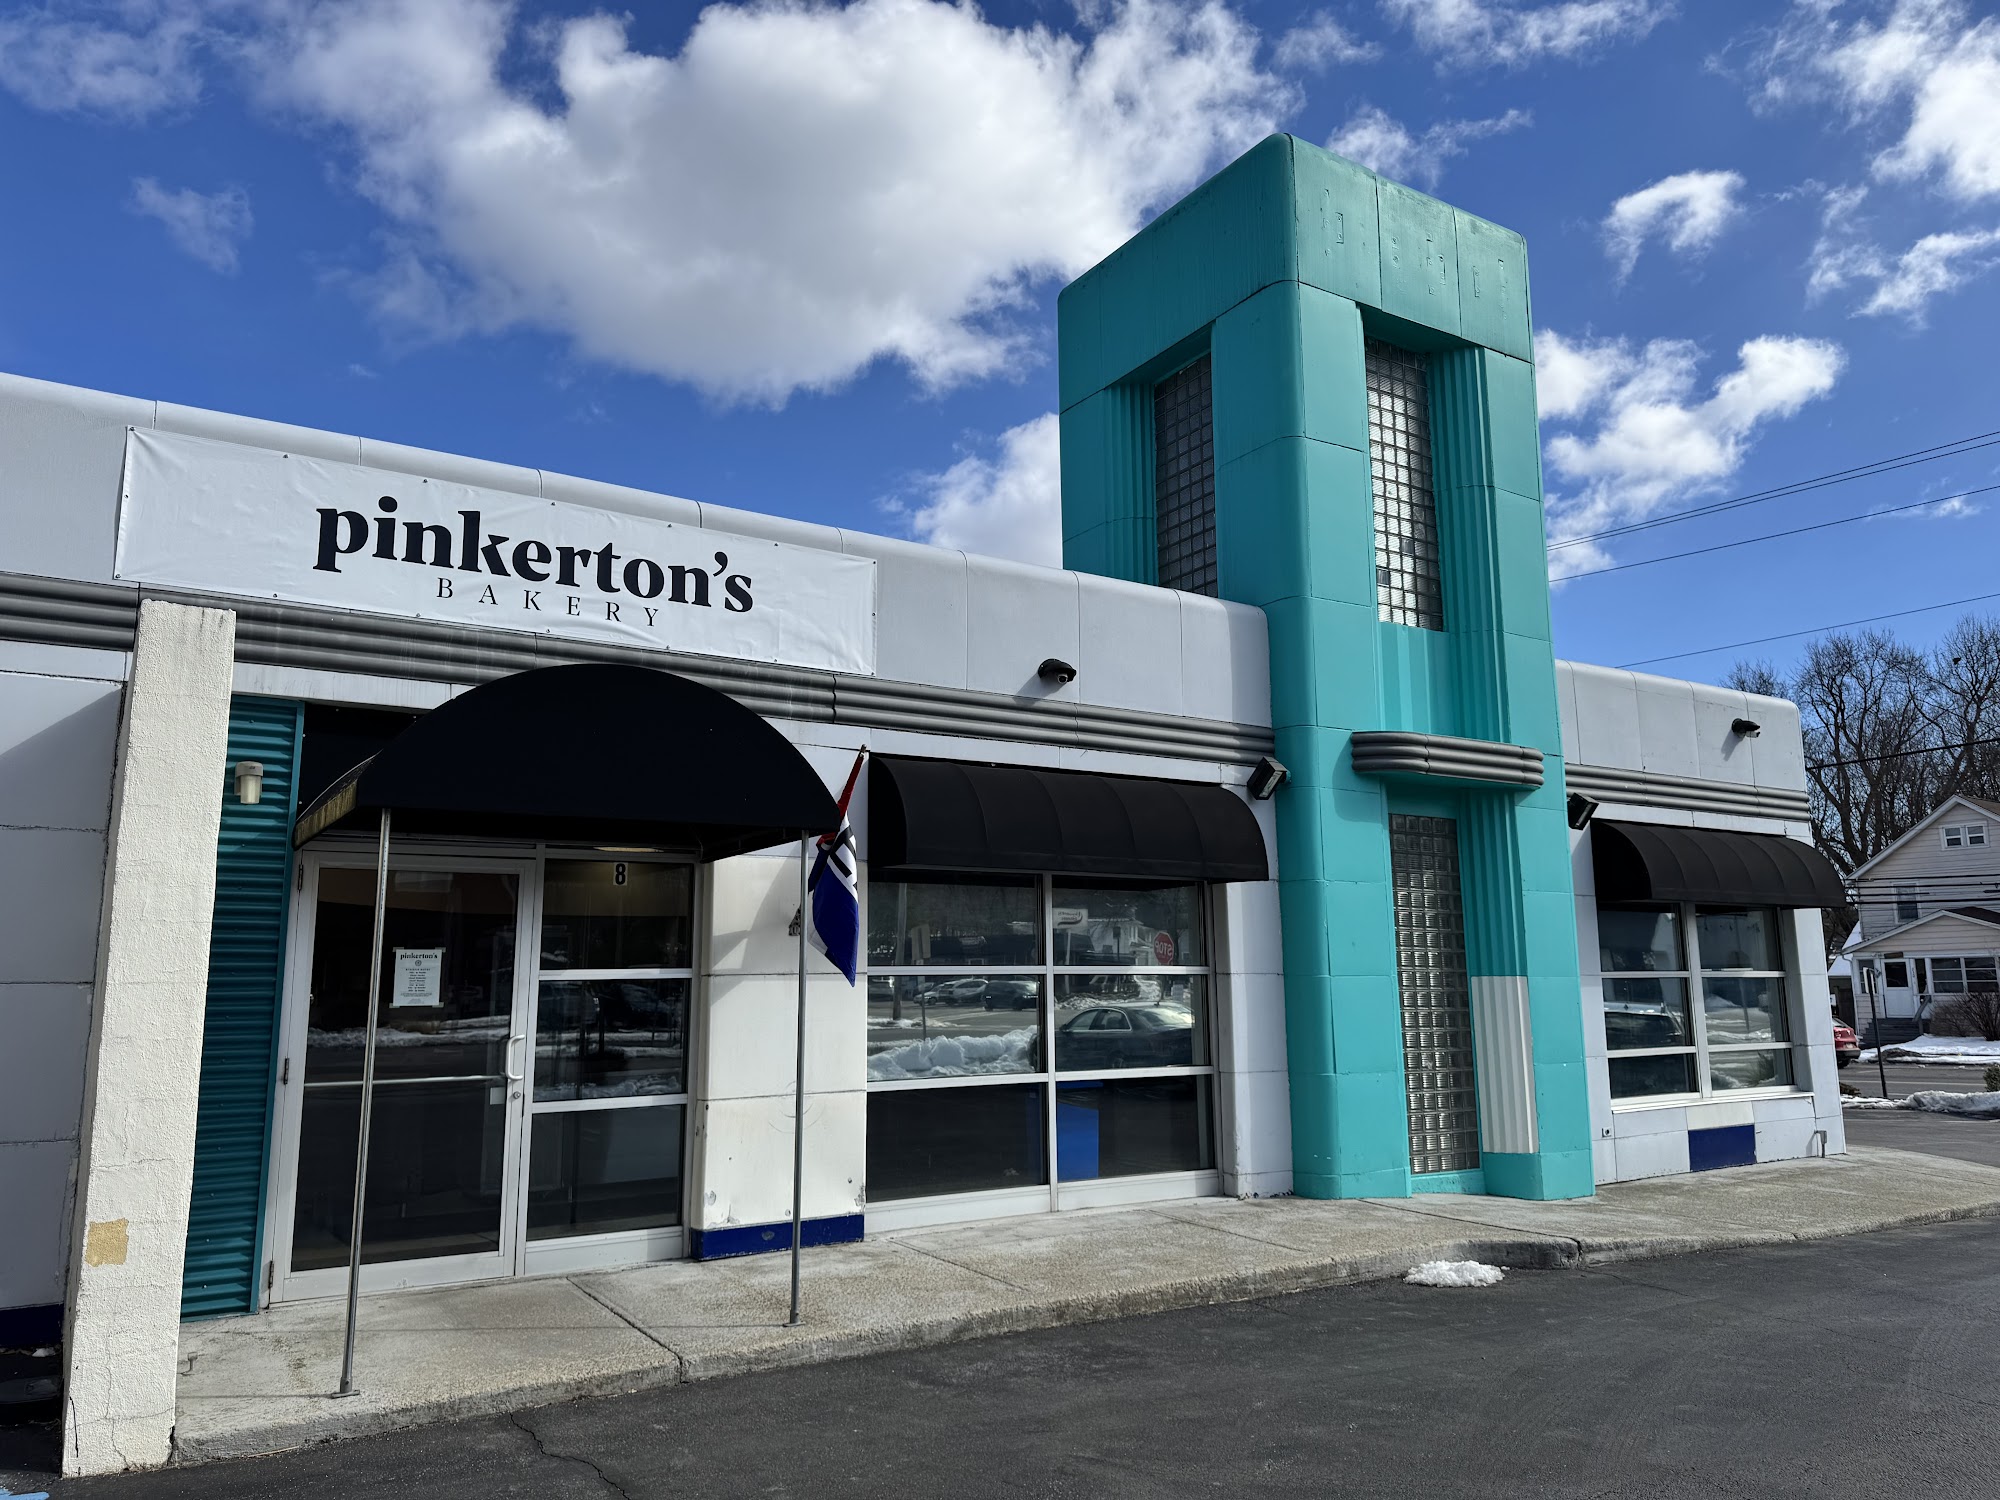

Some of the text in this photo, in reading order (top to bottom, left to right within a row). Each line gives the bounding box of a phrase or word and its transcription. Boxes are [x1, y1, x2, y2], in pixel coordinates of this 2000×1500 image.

[313, 496, 753, 613] pinkerton's
[436, 577, 659, 627] BAKERY
[615, 863, 626, 885] 8
